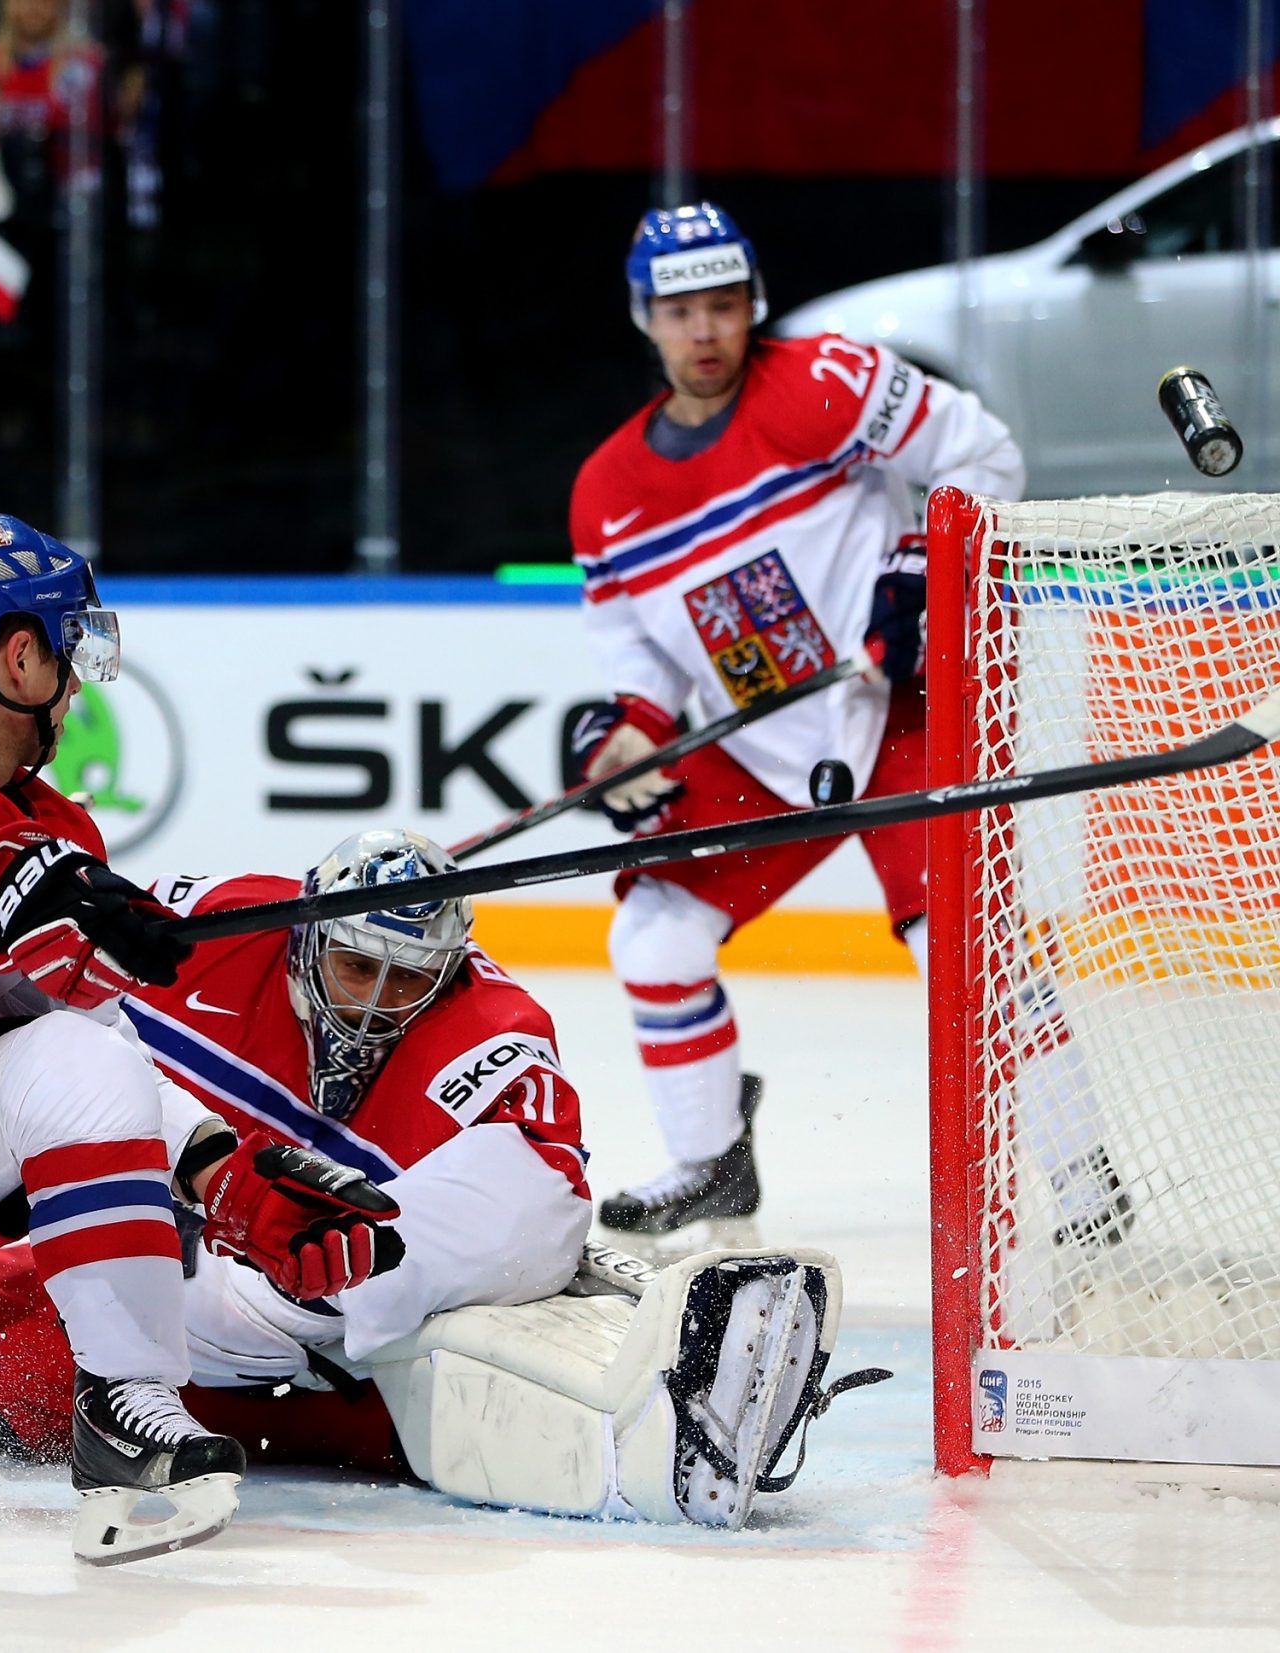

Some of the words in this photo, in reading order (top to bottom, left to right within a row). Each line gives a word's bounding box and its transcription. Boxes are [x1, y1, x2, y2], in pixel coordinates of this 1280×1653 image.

[439, 1041, 558, 1112] ŠKODA
[982, 1376, 1003, 1387] IIHF
[1017, 1379, 1042, 1389] 2015
[1016, 1393, 1032, 1401] ICE
[1034, 1394, 1073, 1403] HOCKEY
[1016, 1401, 1051, 1410] WORLD
[1015, 1409, 1087, 1419] CHAMPIONSHIP
[1015, 1418, 1043, 1426] CZECH
[1044, 1419, 1082, 1427] REPUBLIC
[1015, 1428, 1040, 1436] Prague
[1044, 1428, 1072, 1437] Ostrava
[116, 1441, 138, 1454] CCM
